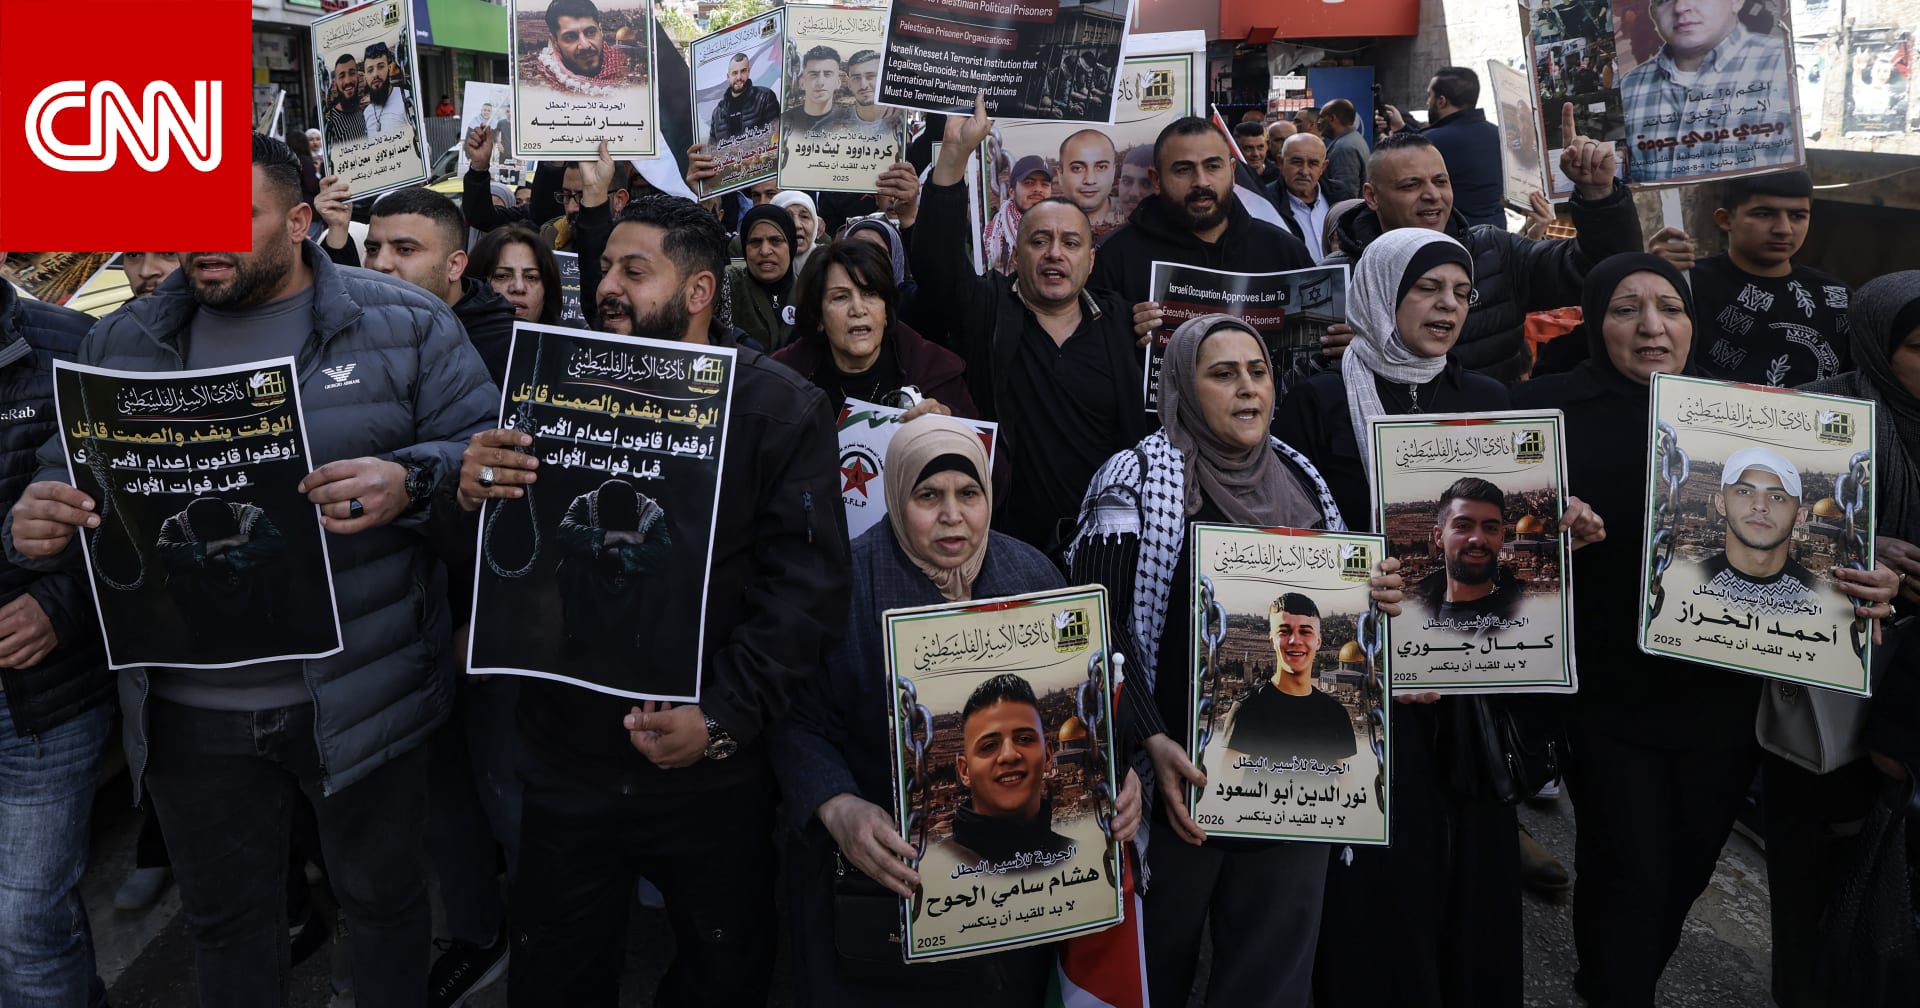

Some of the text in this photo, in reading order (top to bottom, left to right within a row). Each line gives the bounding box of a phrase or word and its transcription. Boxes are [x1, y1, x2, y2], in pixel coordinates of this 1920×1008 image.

[980, 1, 1052, 16] Political Prisoners
[900, 20, 1012, 45] Palestinian Prisoner Organizations:
[890, 43, 1037, 70] Israeli Knesset A Terrorist Institution that
[889, 57, 922, 72] Legalizes
[923, 63, 958, 78] Genocide;
[960, 68, 968, 79] its
[970, 70, 1014, 84] Membership
[886, 72, 1017, 96] International Parliaments and Unions
[1736, 80, 1770, 97] الحكم
[545, 101, 570, 112] البطل
[599, 101, 626, 112] الحرية
[885, 85, 999, 112] Must be Terminated Immetely
[598, 116, 644, 130] يسار
[1686, 104, 1731, 124] الرفيق
[550, 135, 574, 144] ينكسر
[1638, 121, 1784, 151] وجدي عزمي جودة
[795, 142, 893, 159] كرم داوود ليث داوود
[1169, 283, 1285, 303] Israeli Occupation Approves Law To
[1162, 306, 1184, 318] Execute
[1246, 316, 1280, 324] Prisoners
[9, 406, 36, 420] Rab
[552, 392, 620, 418] والصمت
[625, 400, 663, 423] ينفد
[238, 415, 293, 431] الوقت
[667, 404, 719, 428] الوقت
[112, 427, 184, 446] والصمت
[190, 424, 233, 441] ينفد
[575, 424, 714, 460] أوقفوا قانون إعدام
[147, 439, 296, 473] أوقفوا قانون إعدام
[546, 448, 661, 480] قبل فوات الأوان
[125, 471, 247, 496] قبل فوات الأوان
[1693, 584, 1821, 615] الحرية البطل
[1423, 618, 1454, 631] البطل
[1492, 617, 1528, 629] الحرية
[1675, 601, 1838, 645] أحمد الخراز
[1398, 634, 1554, 658] كمال جوري
[1654, 634, 1682, 647] 2025
[1695, 633, 1816, 662] لا بد للقيد أن ينكسر
[1427, 660, 1527, 673] لا بد للقيد أن ينكسر
[1394, 673, 1417, 681] 2025
[1232, 756, 1268, 773] البطل
[1312, 759, 1350, 776] الحرية
[1216, 779, 1367, 808] نور الدين أبو السعود
[1198, 814, 1224, 825] 2026
[1237, 811, 1346, 828] لا بد للقيد أن ينكسر
[1034, 845, 1078, 866] الحرية
[950, 861, 989, 880] البطل
[927, 866, 1099, 917] هشام سامي الحوح
[958, 900, 1075, 934] لا بد للقيد أن ينكسر
[917, 936, 946, 949] 2025
